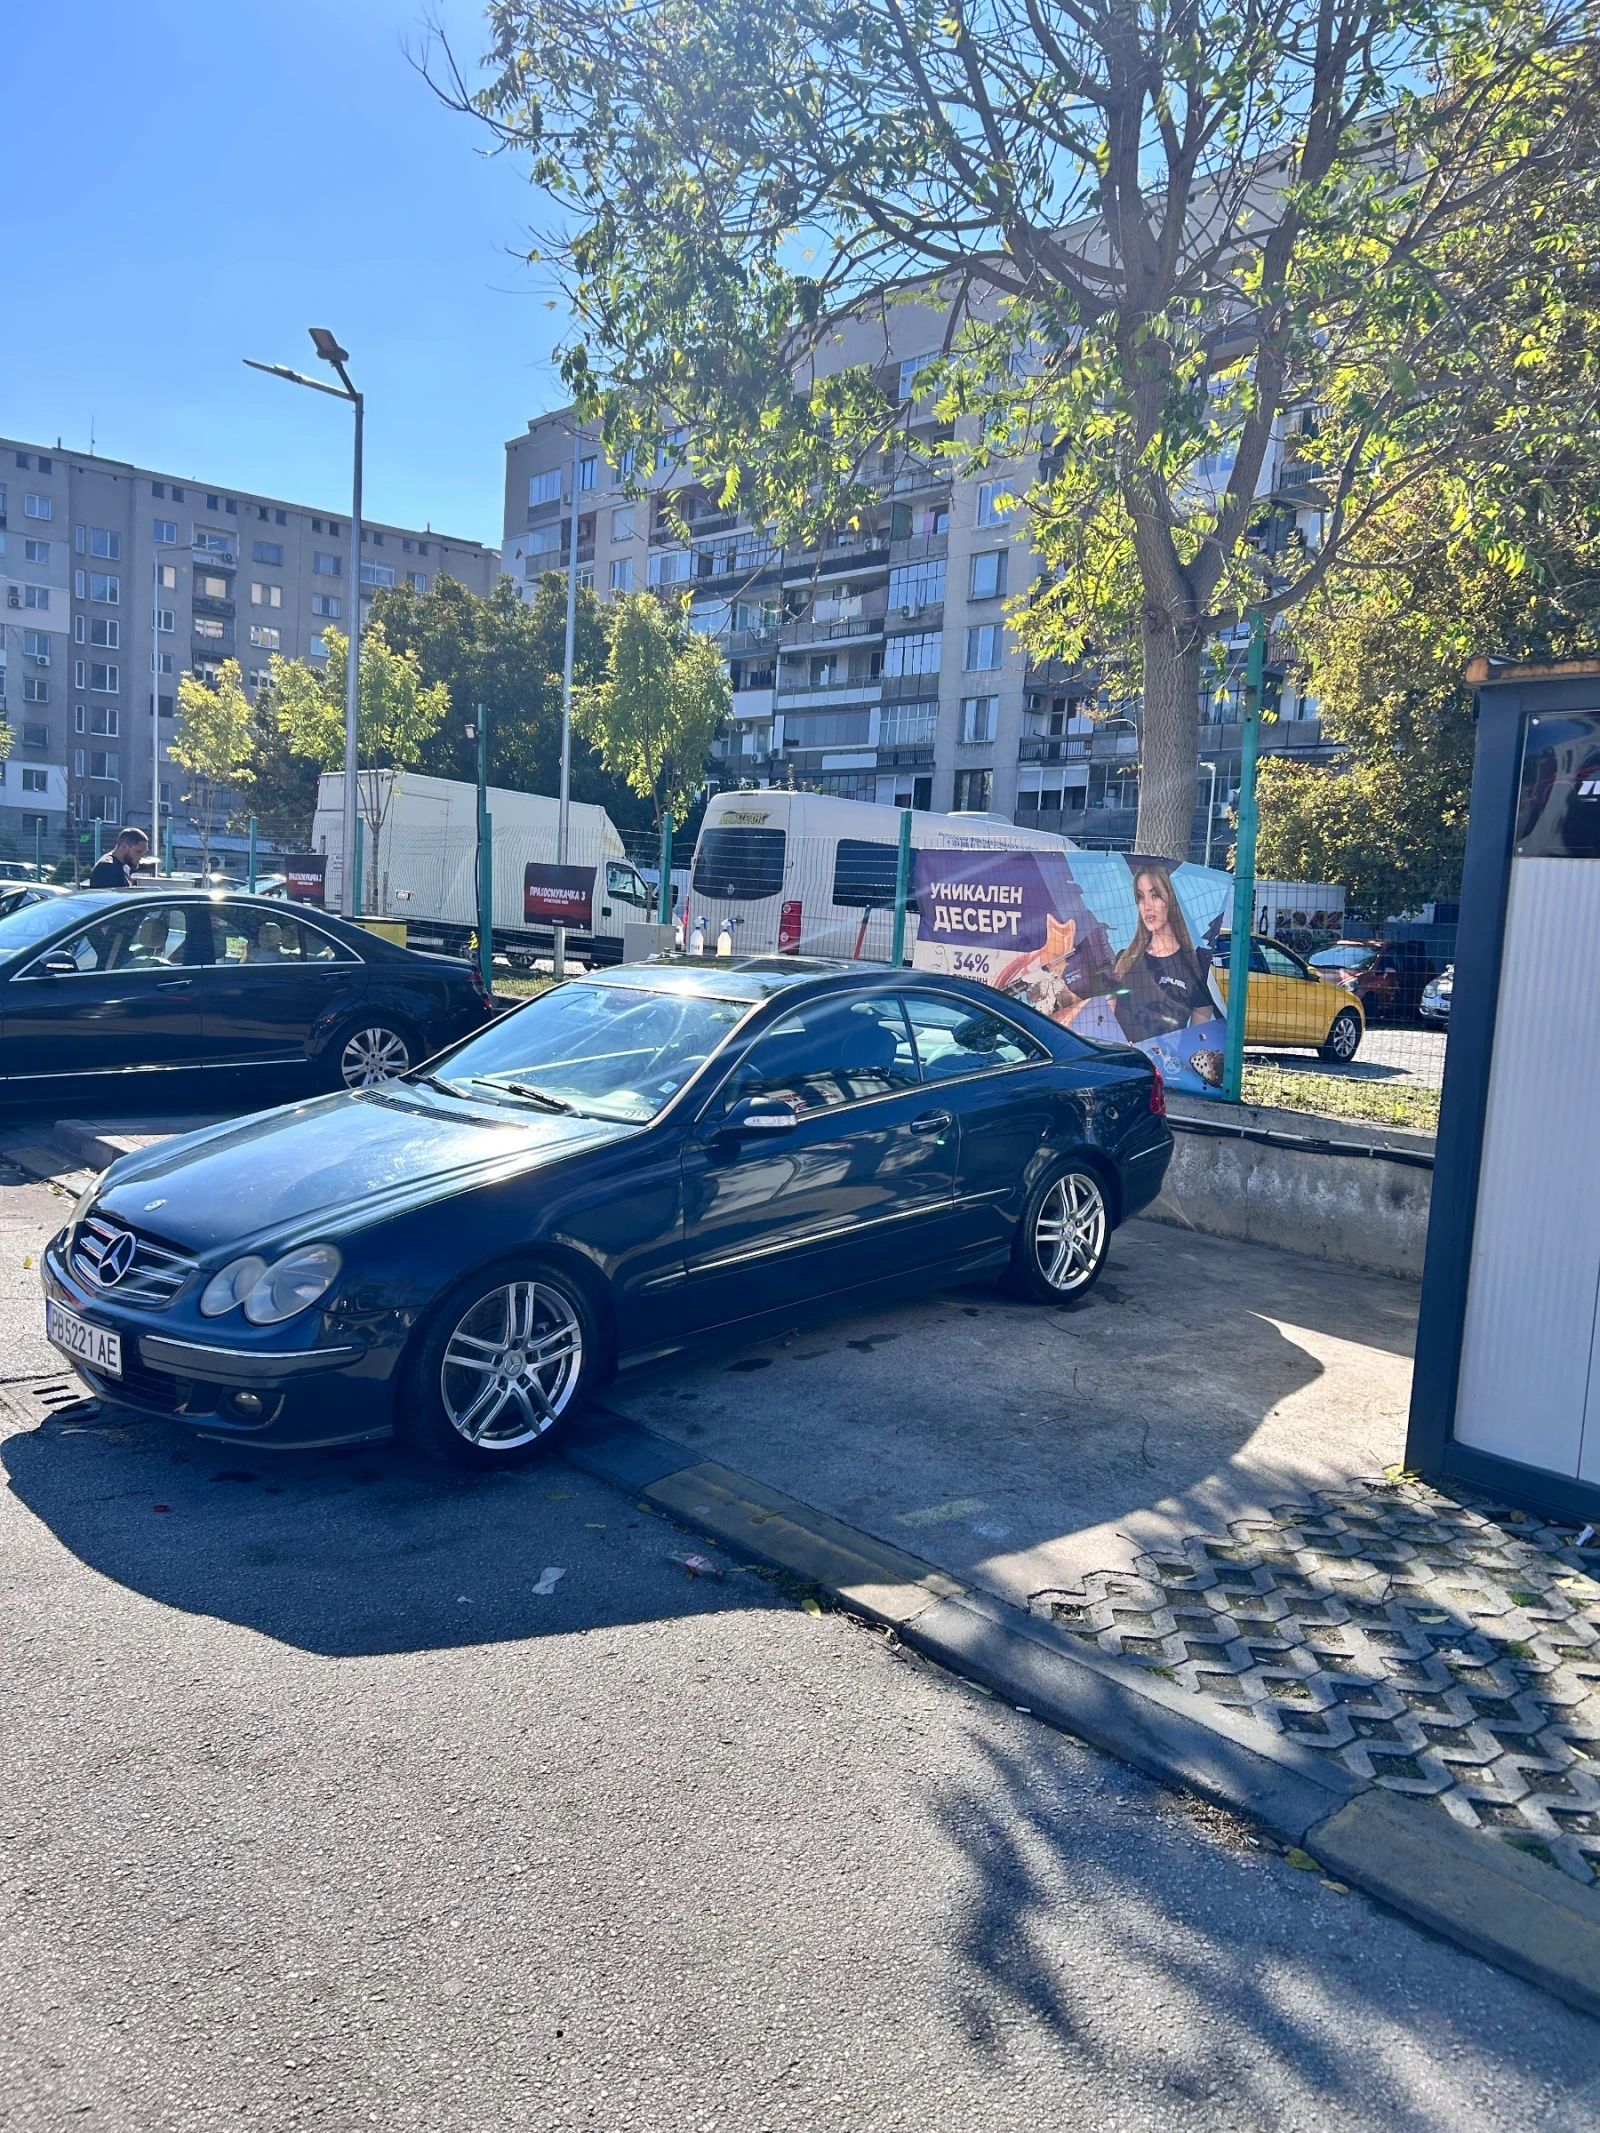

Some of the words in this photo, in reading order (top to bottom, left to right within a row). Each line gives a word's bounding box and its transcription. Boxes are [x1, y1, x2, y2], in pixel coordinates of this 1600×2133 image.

[581, 890, 586, 901] 3
[931, 883, 1022, 904] УНИКАЛЕН
[933, 905, 1022, 936] ДЕСЕРТ
[953, 952, 989, 973] 34%
